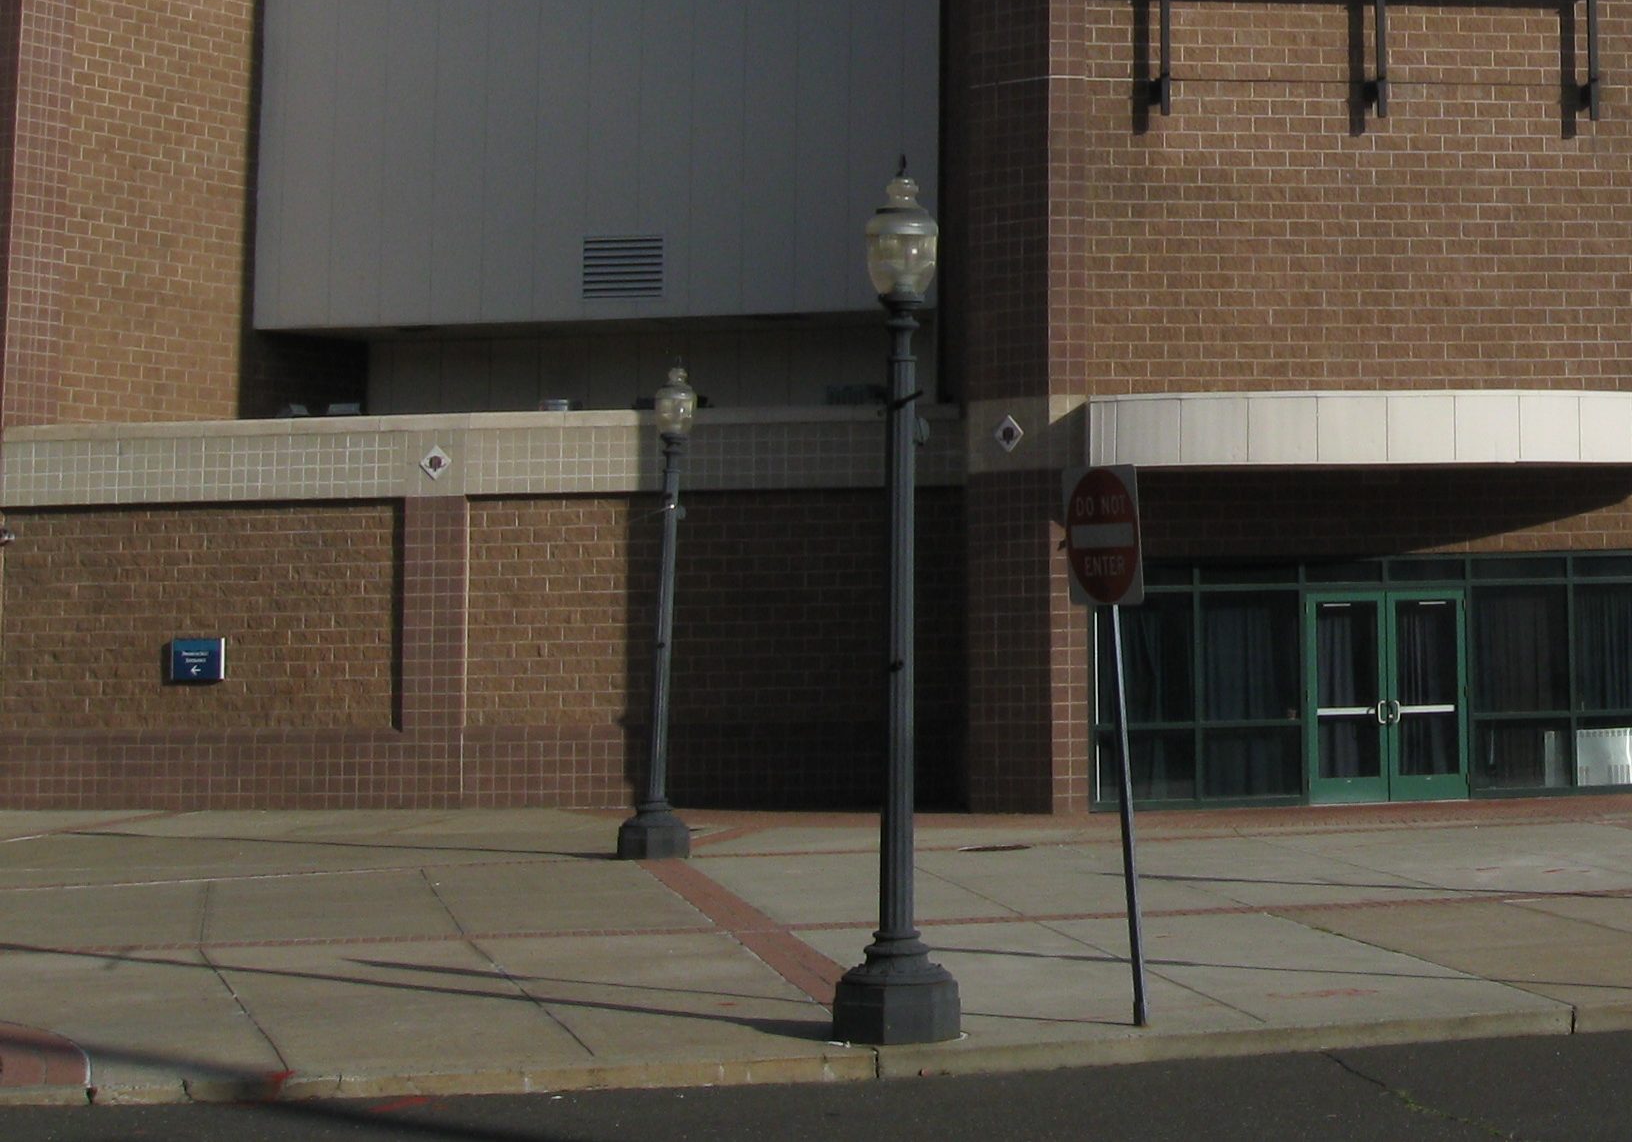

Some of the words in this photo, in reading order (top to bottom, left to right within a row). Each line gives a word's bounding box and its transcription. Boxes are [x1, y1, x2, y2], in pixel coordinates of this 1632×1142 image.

[1076, 495, 1095, 517] DO
[1101, 494, 1127, 515] NOT
[1085, 555, 1127, 577] ENTER
